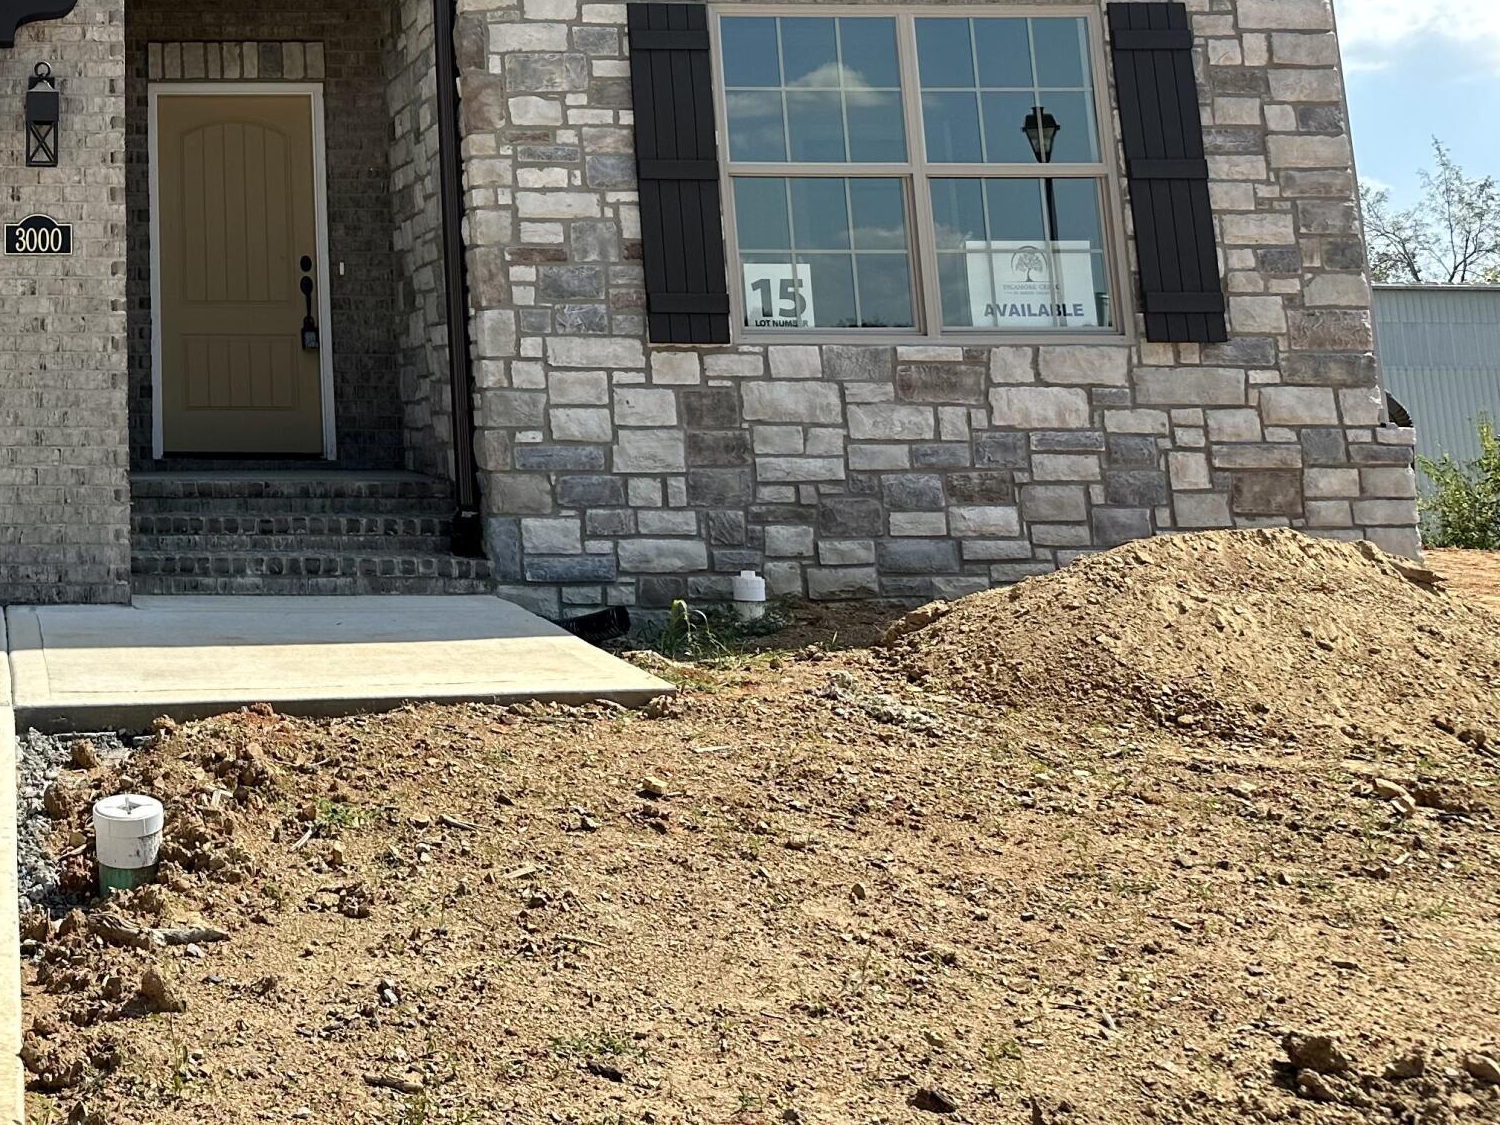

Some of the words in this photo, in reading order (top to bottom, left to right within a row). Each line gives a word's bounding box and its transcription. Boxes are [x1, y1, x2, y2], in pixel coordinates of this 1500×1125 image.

[15, 227, 62, 252] 3000
[751, 279, 806, 317] 15
[984, 303, 1084, 317] AVAILABLE
